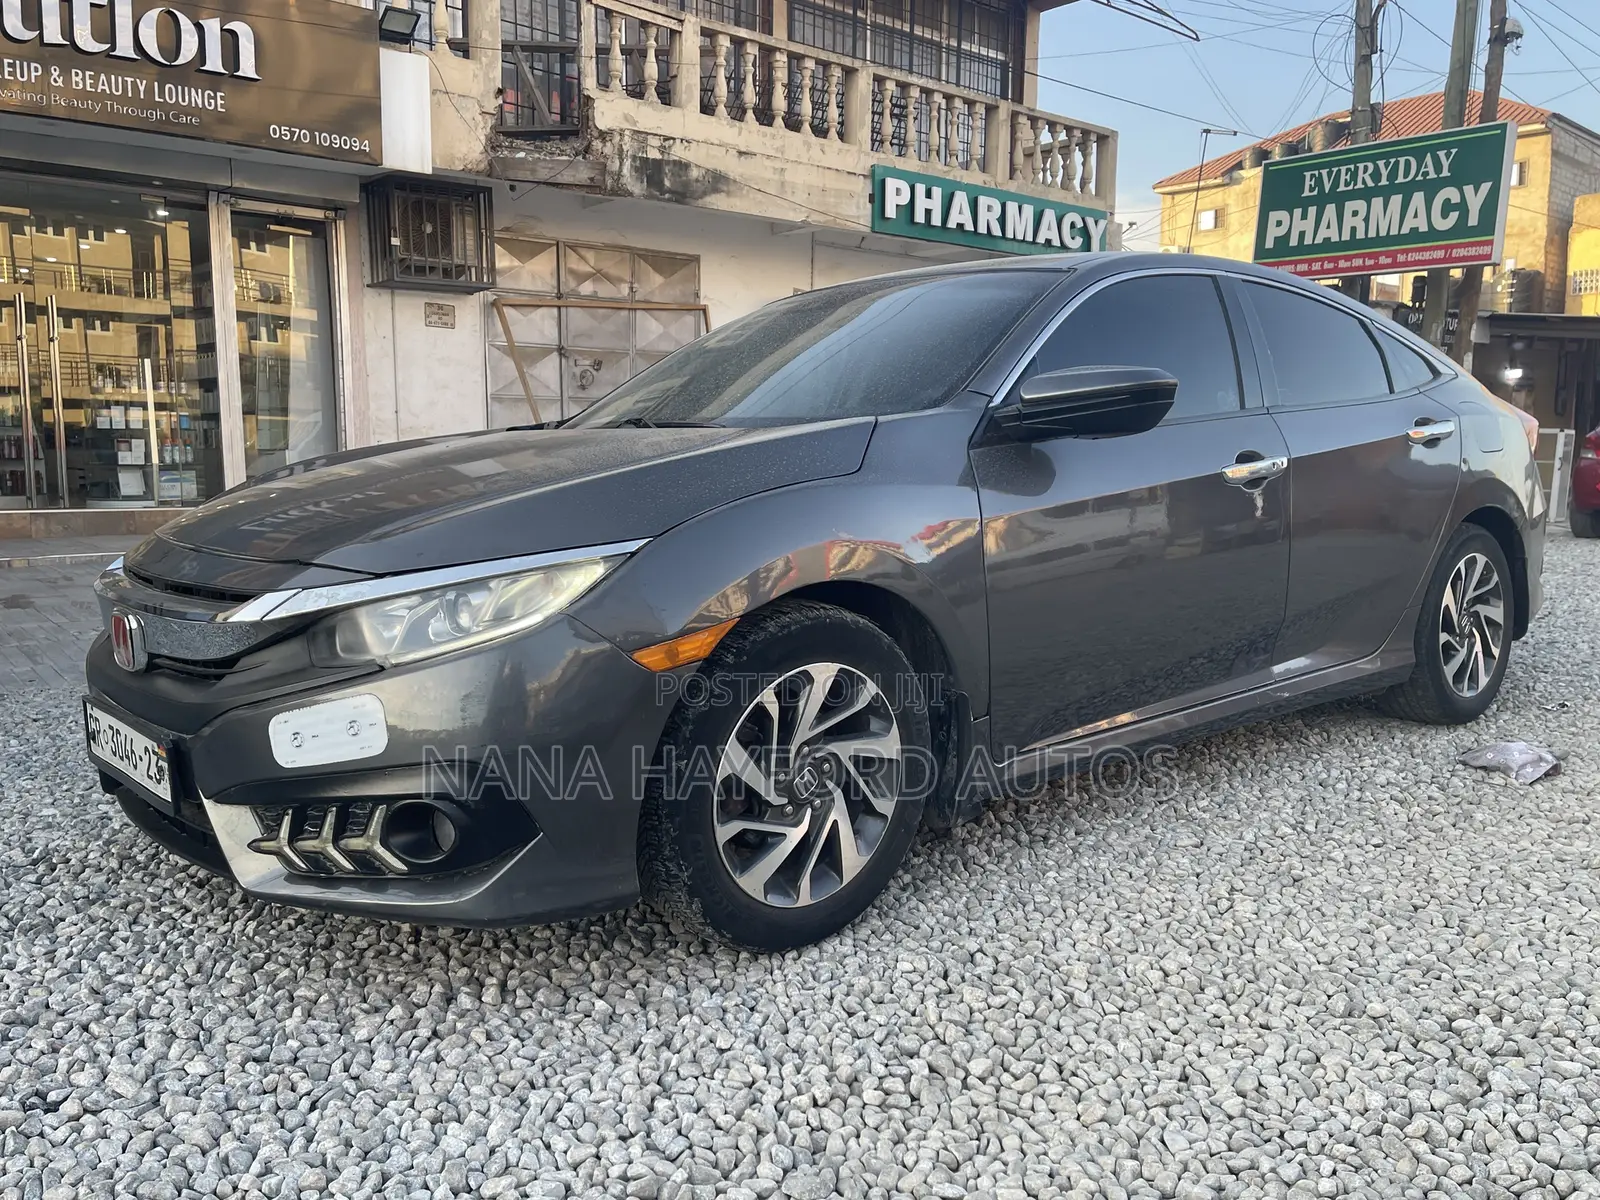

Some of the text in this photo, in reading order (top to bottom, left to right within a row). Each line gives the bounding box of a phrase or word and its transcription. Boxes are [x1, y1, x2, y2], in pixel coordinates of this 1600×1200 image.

[0, 58, 226, 113] EUP & BEAUTY LOUNGE
[51, 93, 102, 112] Beauty
[106, 100, 166, 122] Through
[169, 110, 201, 126] Care
[269, 124, 371, 153] 0570 109094
[1301, 148, 1458, 197] EVERYDAY
[884, 177, 1108, 252] PHARMACY
[1264, 181, 1493, 249] PHARMACY
